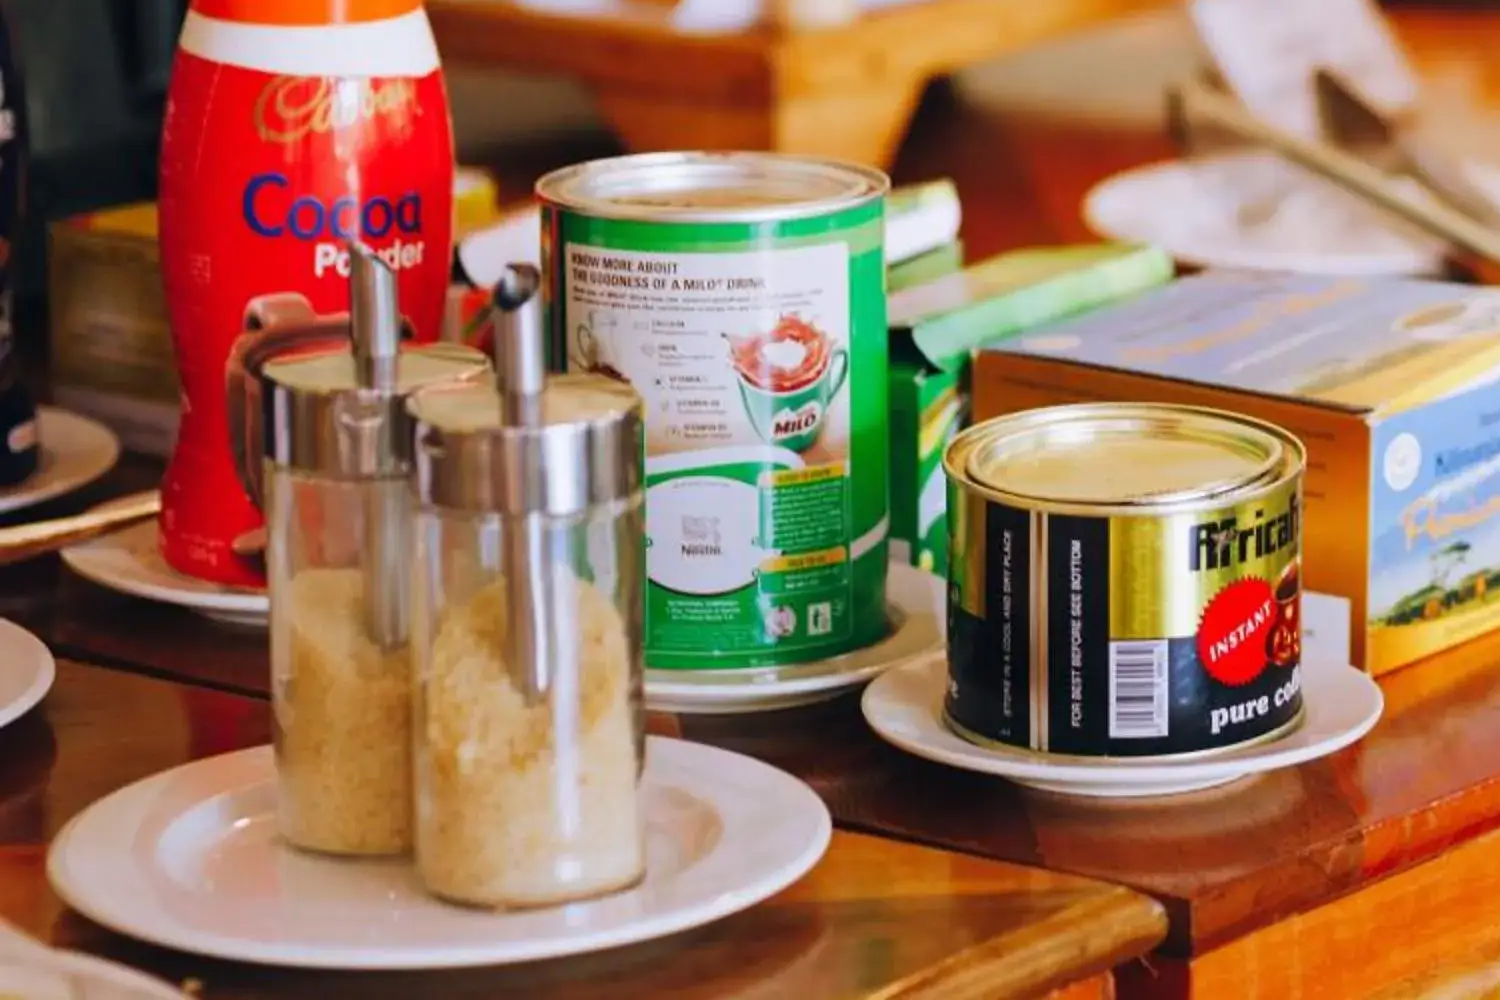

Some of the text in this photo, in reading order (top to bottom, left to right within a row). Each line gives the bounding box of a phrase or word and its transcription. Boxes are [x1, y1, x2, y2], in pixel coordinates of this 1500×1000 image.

[243, 172, 422, 240] Cocoa
[314, 240, 424, 278] Poder
[572, 253, 679, 275] KNOW MORE ABOUT
[572, 268, 588, 282] THE
[589, 269, 649, 289] GOODNESS
[652, 277, 666, 290] OF
[670, 278, 681, 290] A
[727, 277, 766, 291] DRINK
[773, 413, 817, 437] MILO
[1002, 529, 1012, 568] PLACE
[1070, 539, 1082, 728] FOR BEST BEFORE SEE BOTTOM
[1208, 598, 1273, 663] INSTANT
[1210, 694, 1270, 735] pure
